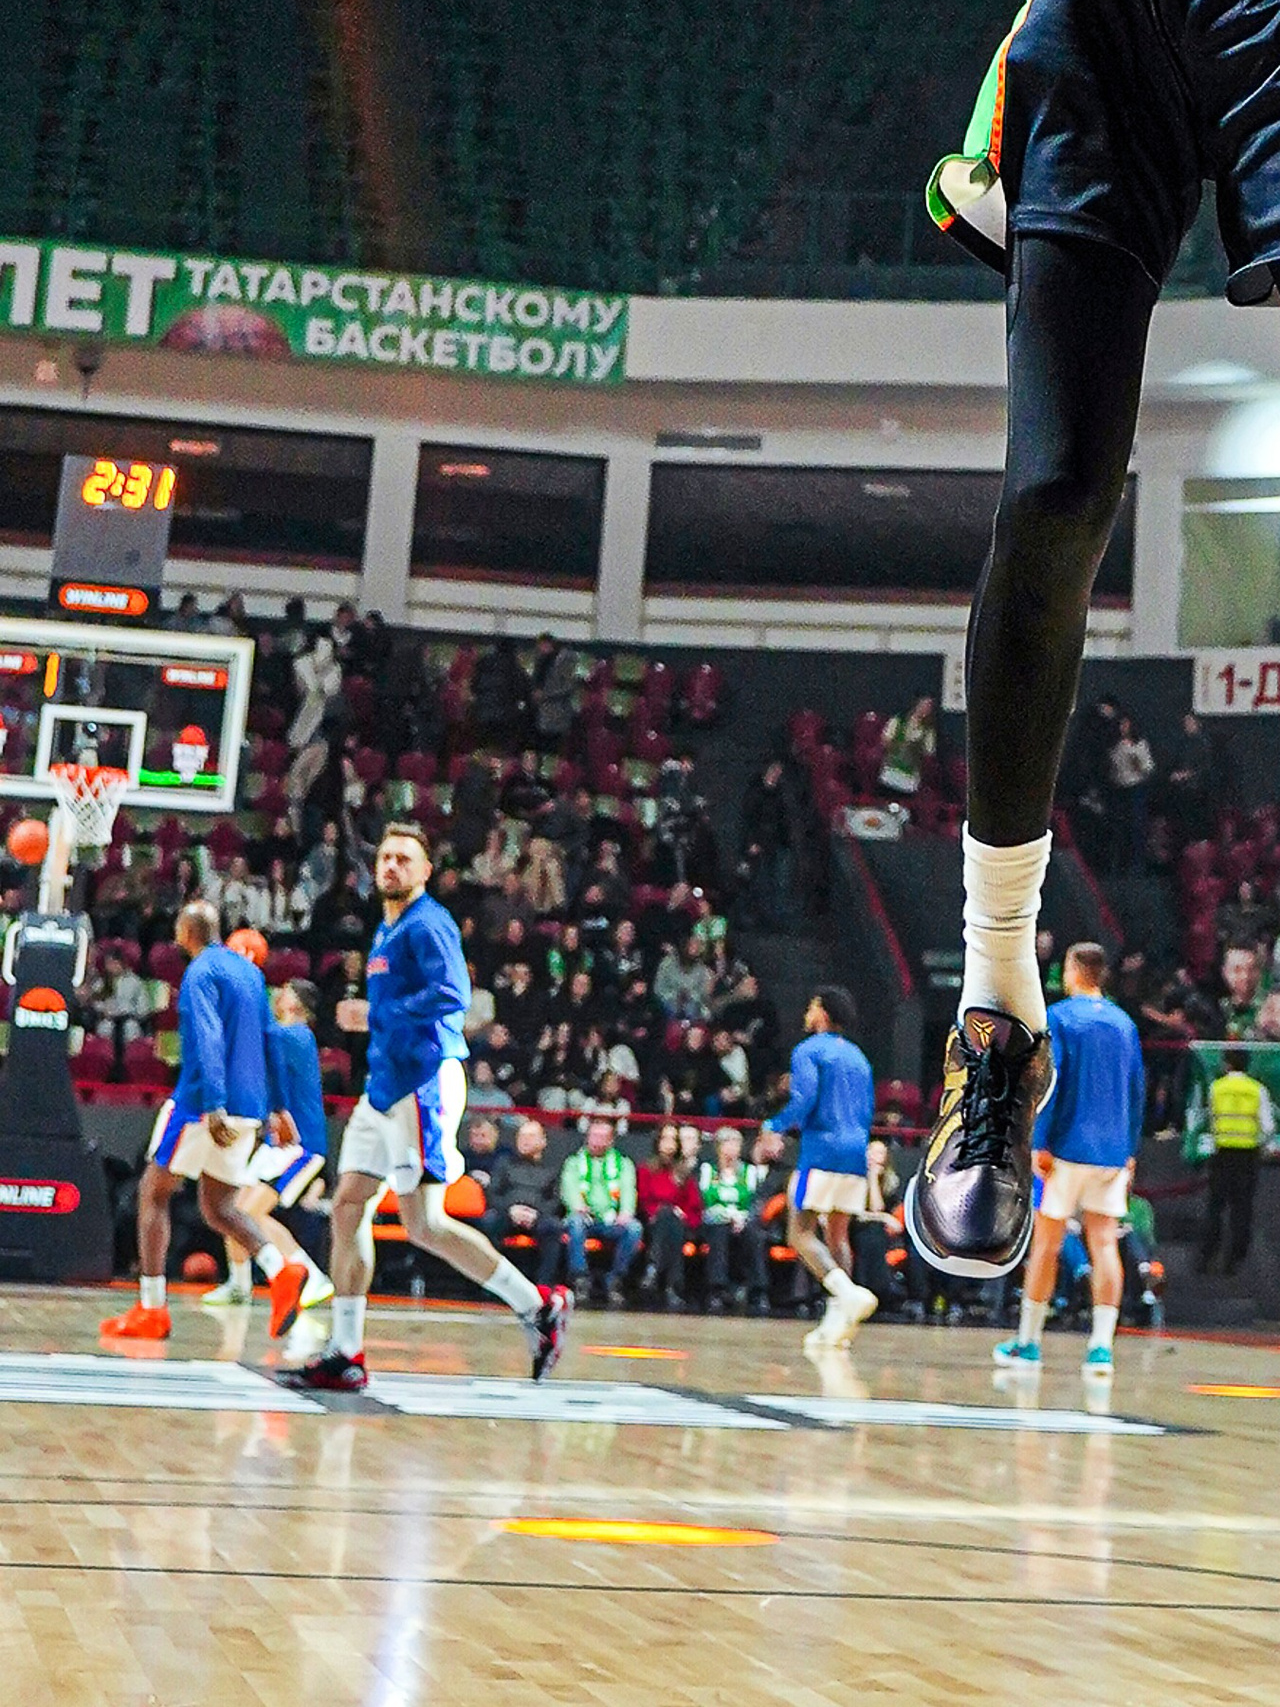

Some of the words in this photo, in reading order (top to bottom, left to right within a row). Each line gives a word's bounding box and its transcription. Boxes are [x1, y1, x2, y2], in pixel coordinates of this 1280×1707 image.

[184, 258, 622, 334] ТАТАРСТАНСКОМУ
[305, 317, 619, 382] БАСКЕТБОЛУ
[82, 458, 176, 511] 2:31
